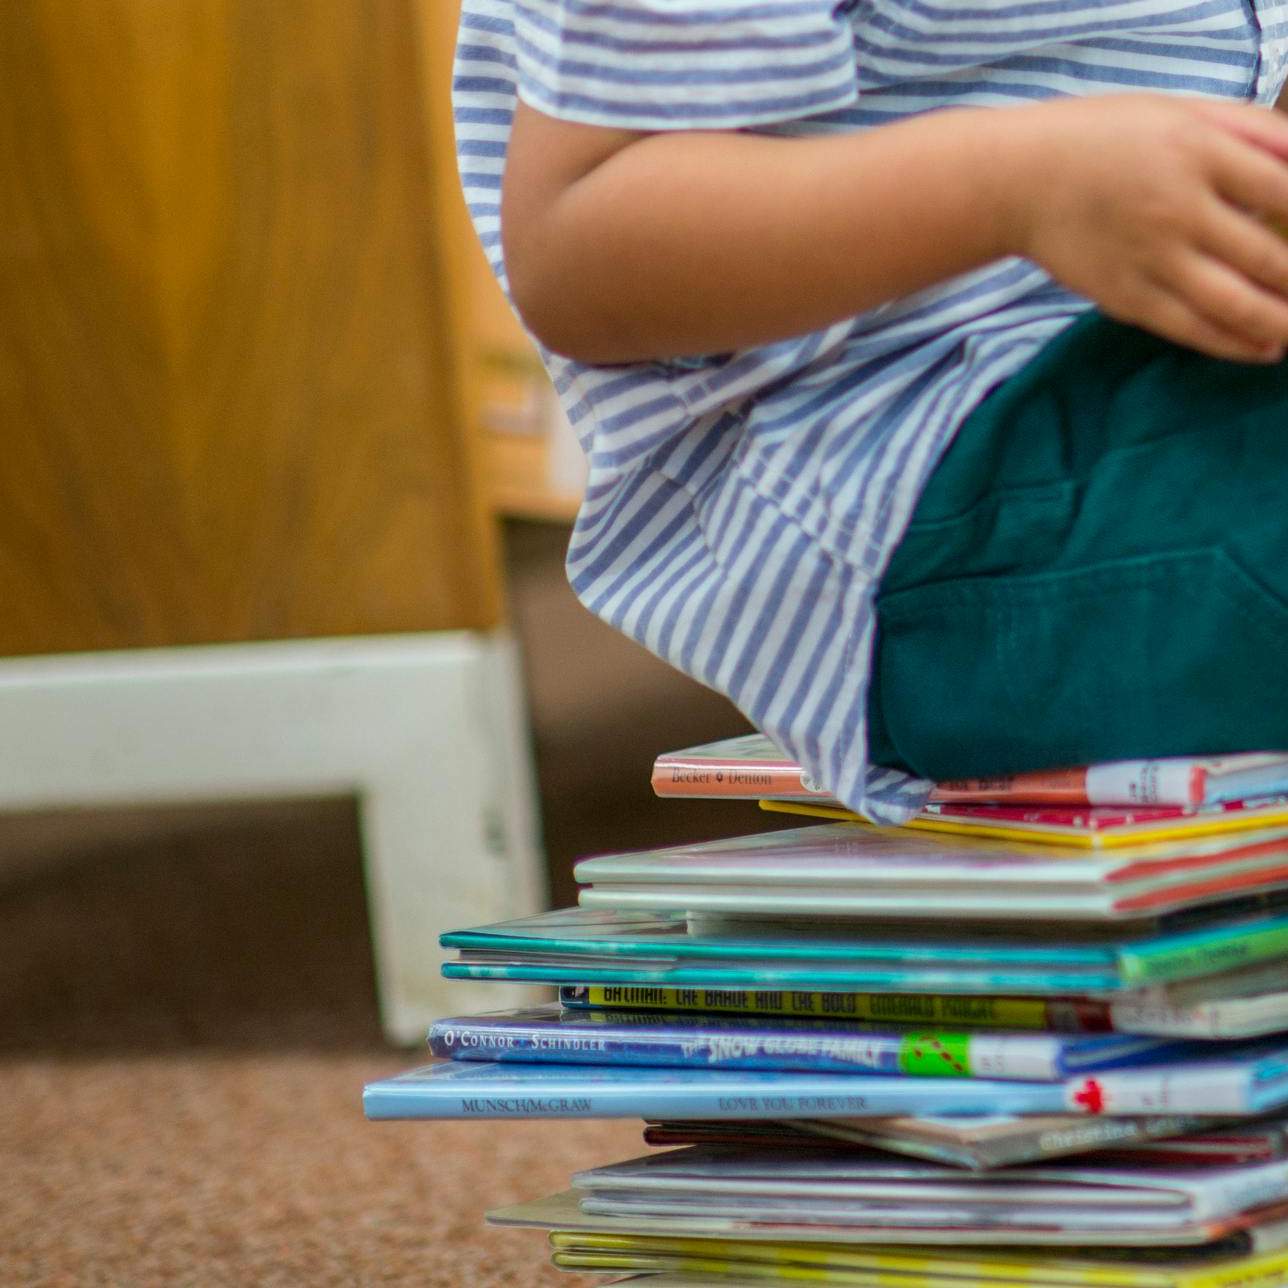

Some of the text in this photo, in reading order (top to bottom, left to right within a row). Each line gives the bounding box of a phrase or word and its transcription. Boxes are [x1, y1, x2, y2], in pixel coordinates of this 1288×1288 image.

[671, 767, 772, 786] Becker Denton
[603, 985, 668, 1006] BATMAN:
[675, 988, 698, 1008] THE
[704, 990, 749, 1010] BRAVE
[756, 992, 783, 1011] AND
[791, 992, 815, 1012] THE
[822, 993, 857, 1014] BOLD
[708, 1036, 758, 1063] SNOW
[718, 1096, 867, 1112] LOVE YOU FOREVER
